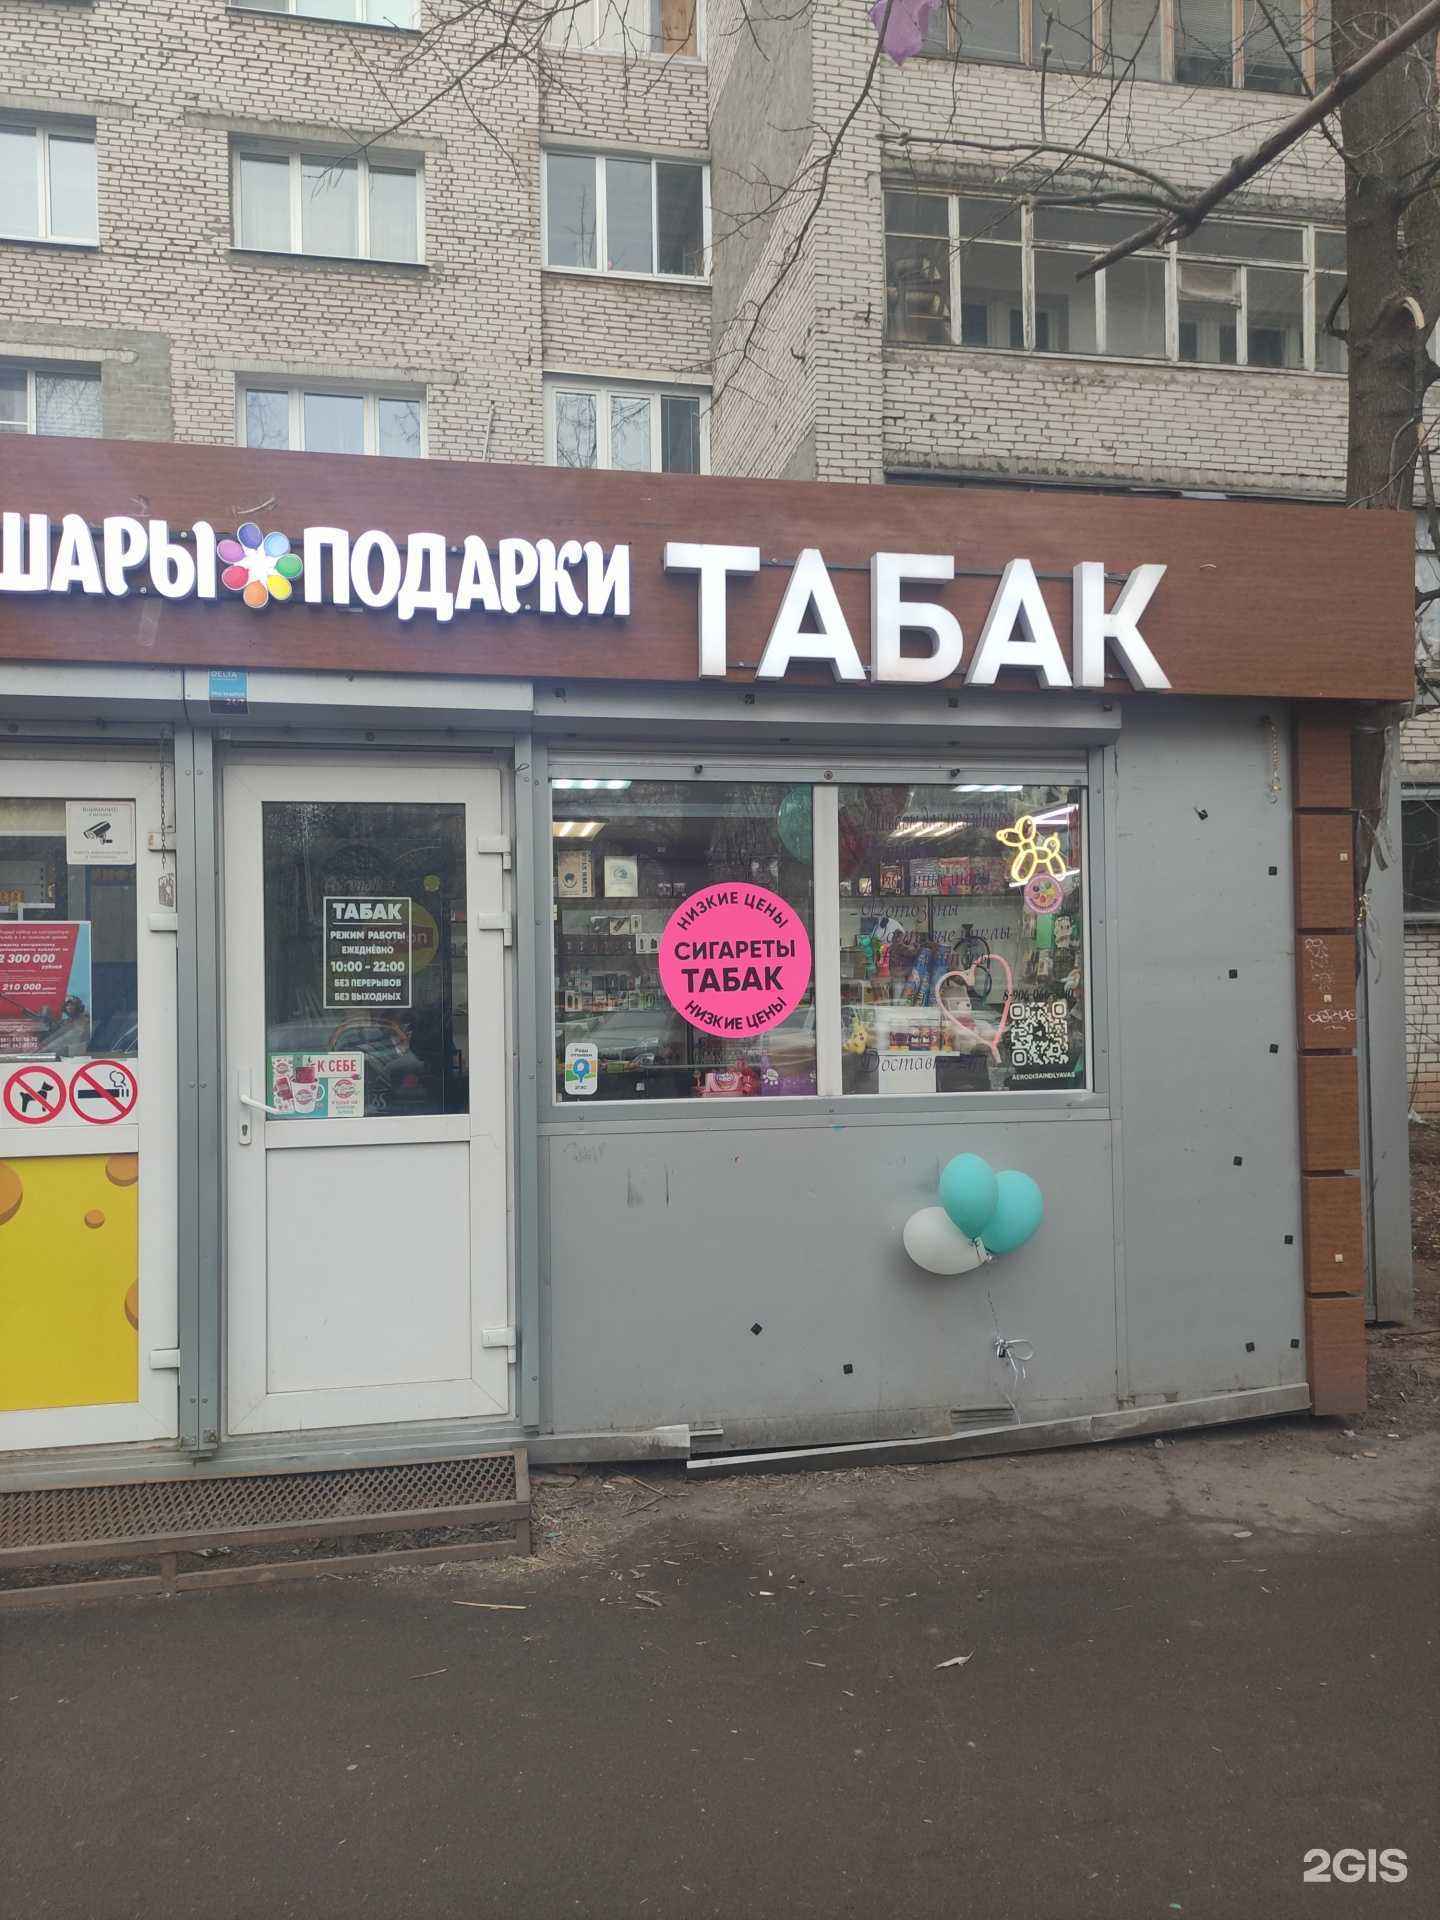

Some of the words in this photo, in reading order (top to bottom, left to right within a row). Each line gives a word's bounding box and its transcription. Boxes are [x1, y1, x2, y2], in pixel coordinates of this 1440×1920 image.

[0, 512, 217, 600] ШАРЫ
[303, 525, 631, 622] ПОДАРКИ
[663, 540, 1173, 692] ТАБАК
[332, 902, 403, 920] ТАБАК
[677, 891, 740, 931] НИЗКИЕ
[744, 892, 789, 930] ЦЕНЫ
[329, 930, 365, 940] РЕЖИМ
[367, 930, 406, 940] РАБОТЫ
[673, 938, 797, 962] СИГАРЕТЫ
[7, 953, 31, 964] 300
[32, 953, 56, 964] 000
[330, 961, 363, 972] 10:00
[372, 961, 405, 972] 22:00
[1, 983, 21, 991] 210
[22, 983, 42, 991] 000
[334, 978, 350, 988] БЕЗ
[350, 978, 402, 988] ПЕРЕРЫВОВ
[681, 965, 784, 994] ТАБАК
[334, 992, 350, 1001] БЕЗ
[350, 992, 402, 1002] ВЫХОДНЫХ
[685, 999, 743, 1031] НИЗКИЕ
[746, 997, 788, 1030] ЦЕНЫ
[317, 1060, 325, 1073] К
[328, 1059, 357, 1073] СЕБЕ
